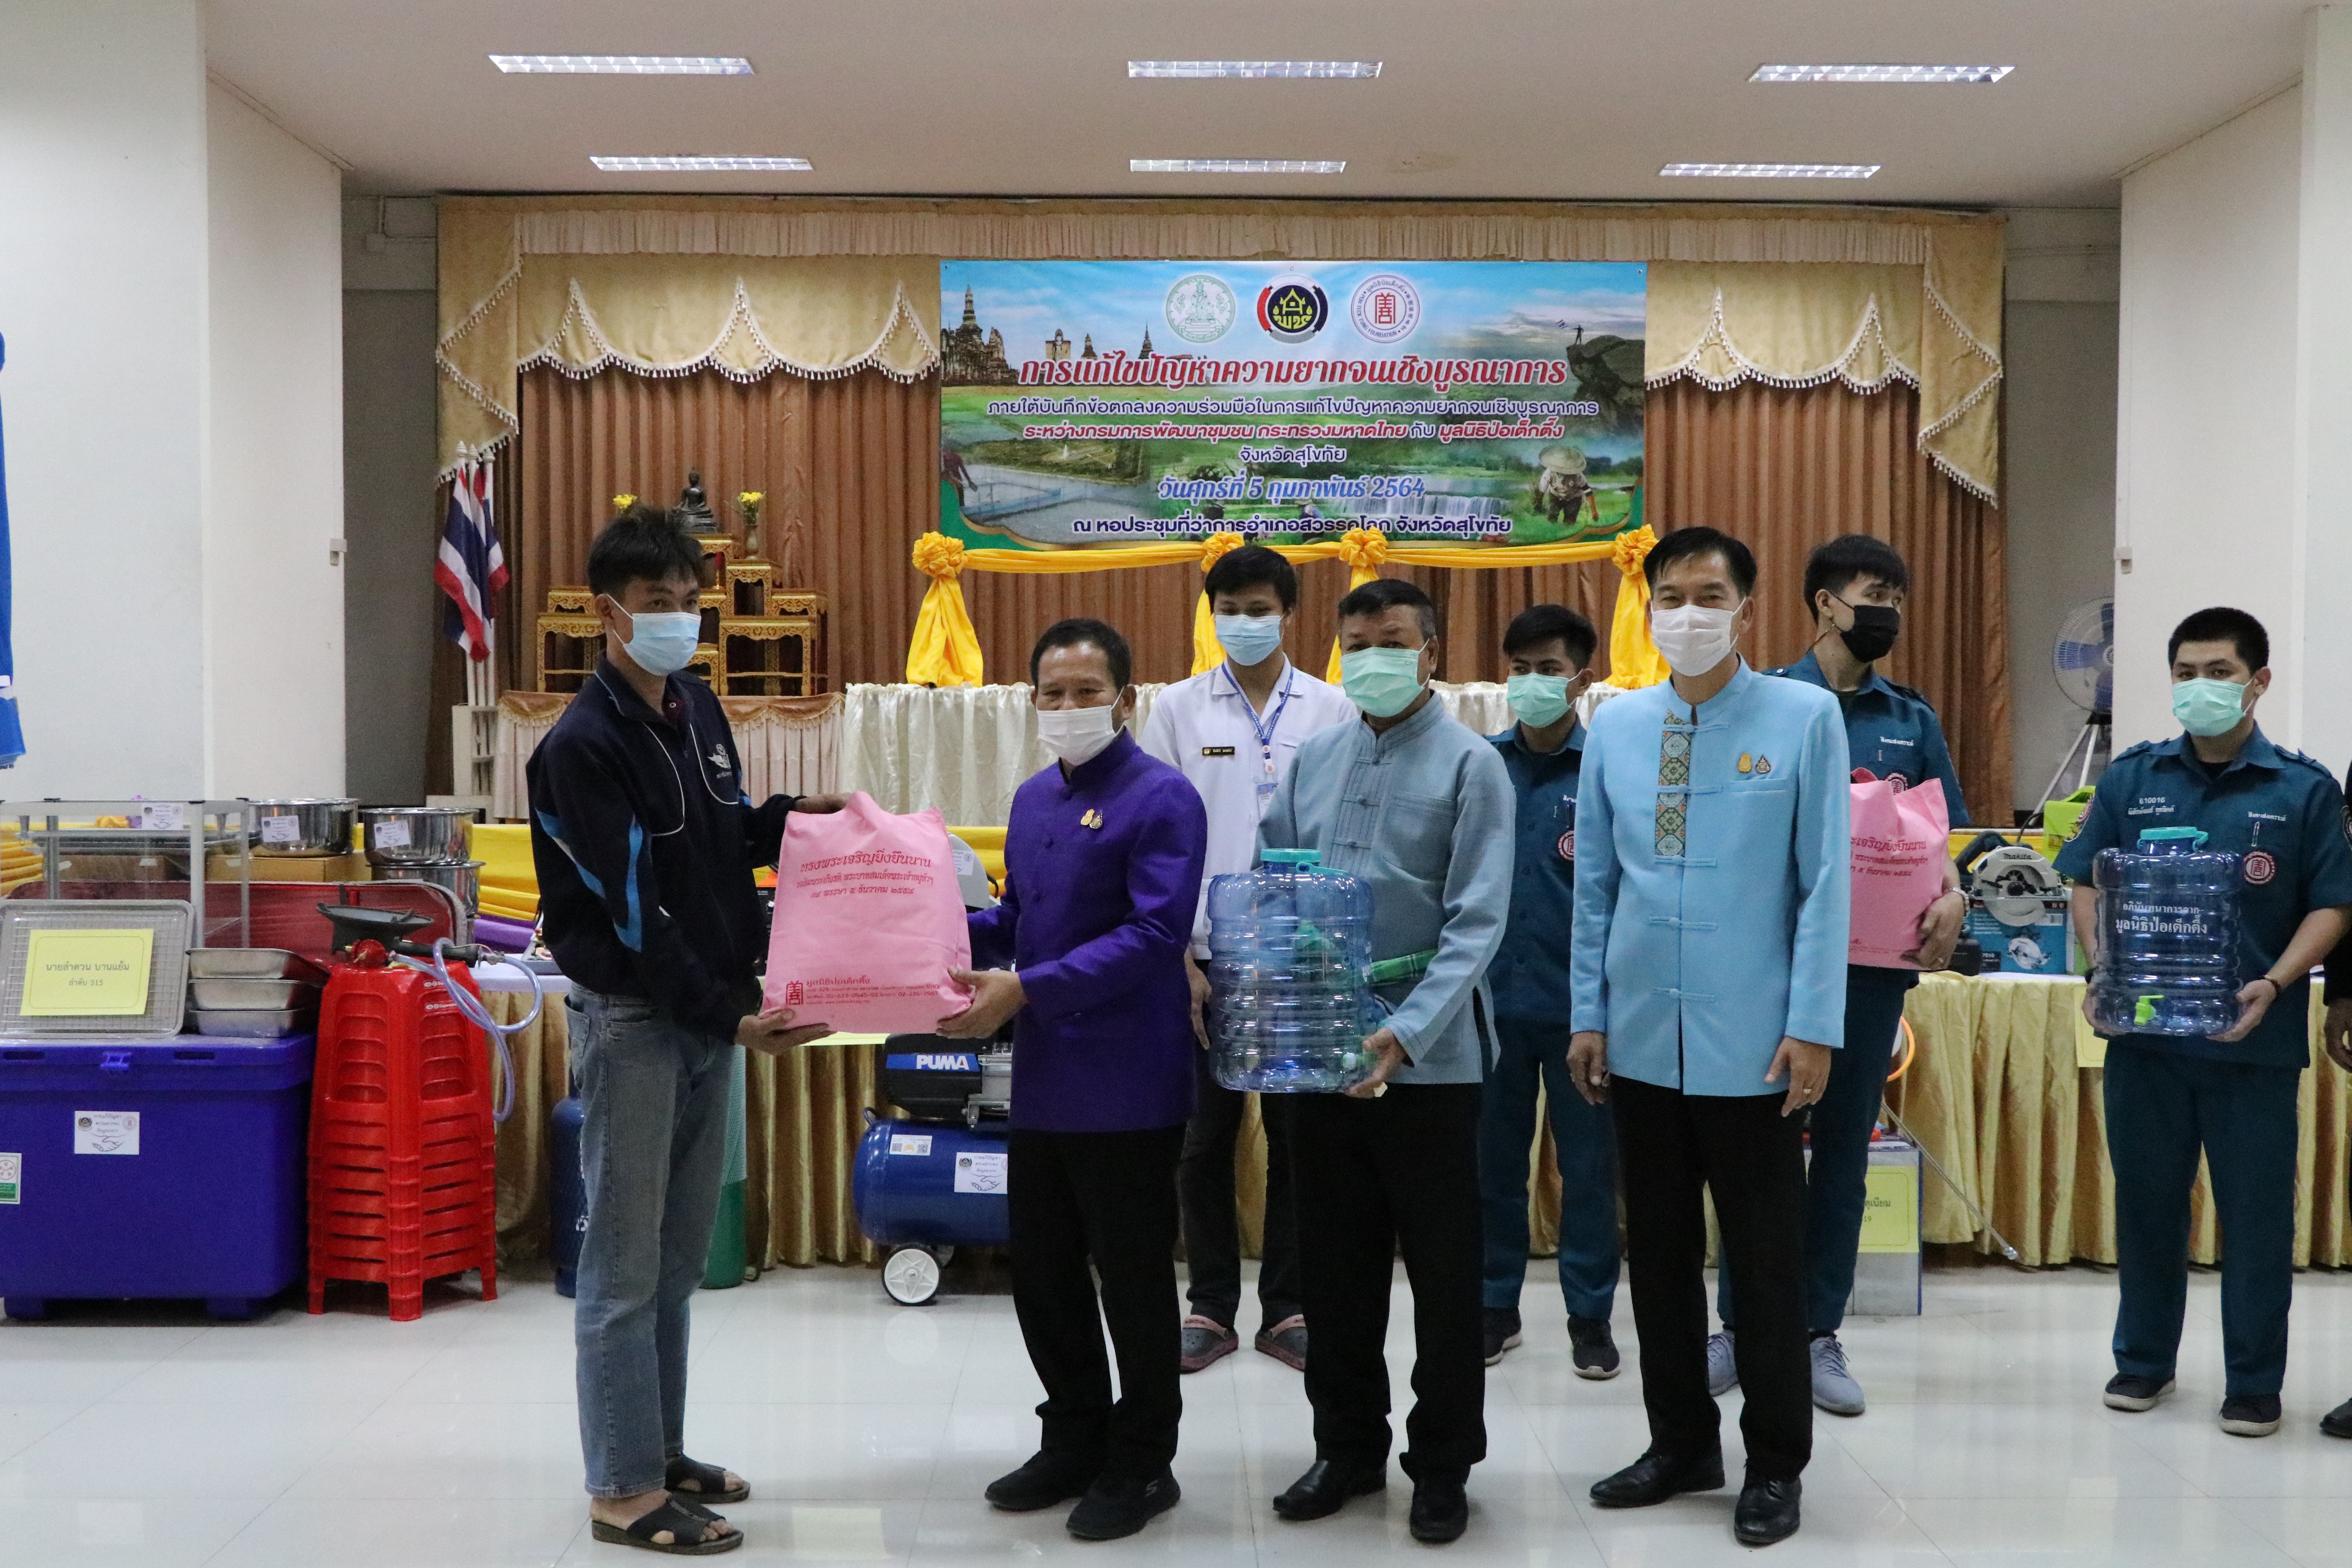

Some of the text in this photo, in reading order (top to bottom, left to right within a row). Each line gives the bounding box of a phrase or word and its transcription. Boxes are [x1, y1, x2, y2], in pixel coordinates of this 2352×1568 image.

[1020, 350, 1566, 392] การแก้ไขปัญหาความยากจนเชิงบูรณาการ
[989, 397, 1599, 417] ภายใต้บันทึกข้อตกลงความร่วมมือในการแก้ไขปัญหาความยากจนเชิงบูรณาการ
[1025, 417, 1564, 443] ระหว่างกรมการพัฒนาชุมชน กระทรวงมหาดไทย กับ มูลนิธิป่อเต็กตึ๊ง
[1240, 446, 1346, 466] จังหวัดสุโขทัย
[1160, 470, 1425, 505] วันศุกร์ที่ 5 กุมภาพันธ์ 2564
[1073, 520, 1091, 532] ณ
[1396, 515, 1512, 538] จังหวัดสุโขทัย
[800, 848, 931, 872] ทรงพระเจริญยิ่งยืนนาน
[2116, 914, 2207, 934] มูลนิธิป่อเต็กตึ๊ง
[916, 1054, 970, 1070] PUMA
